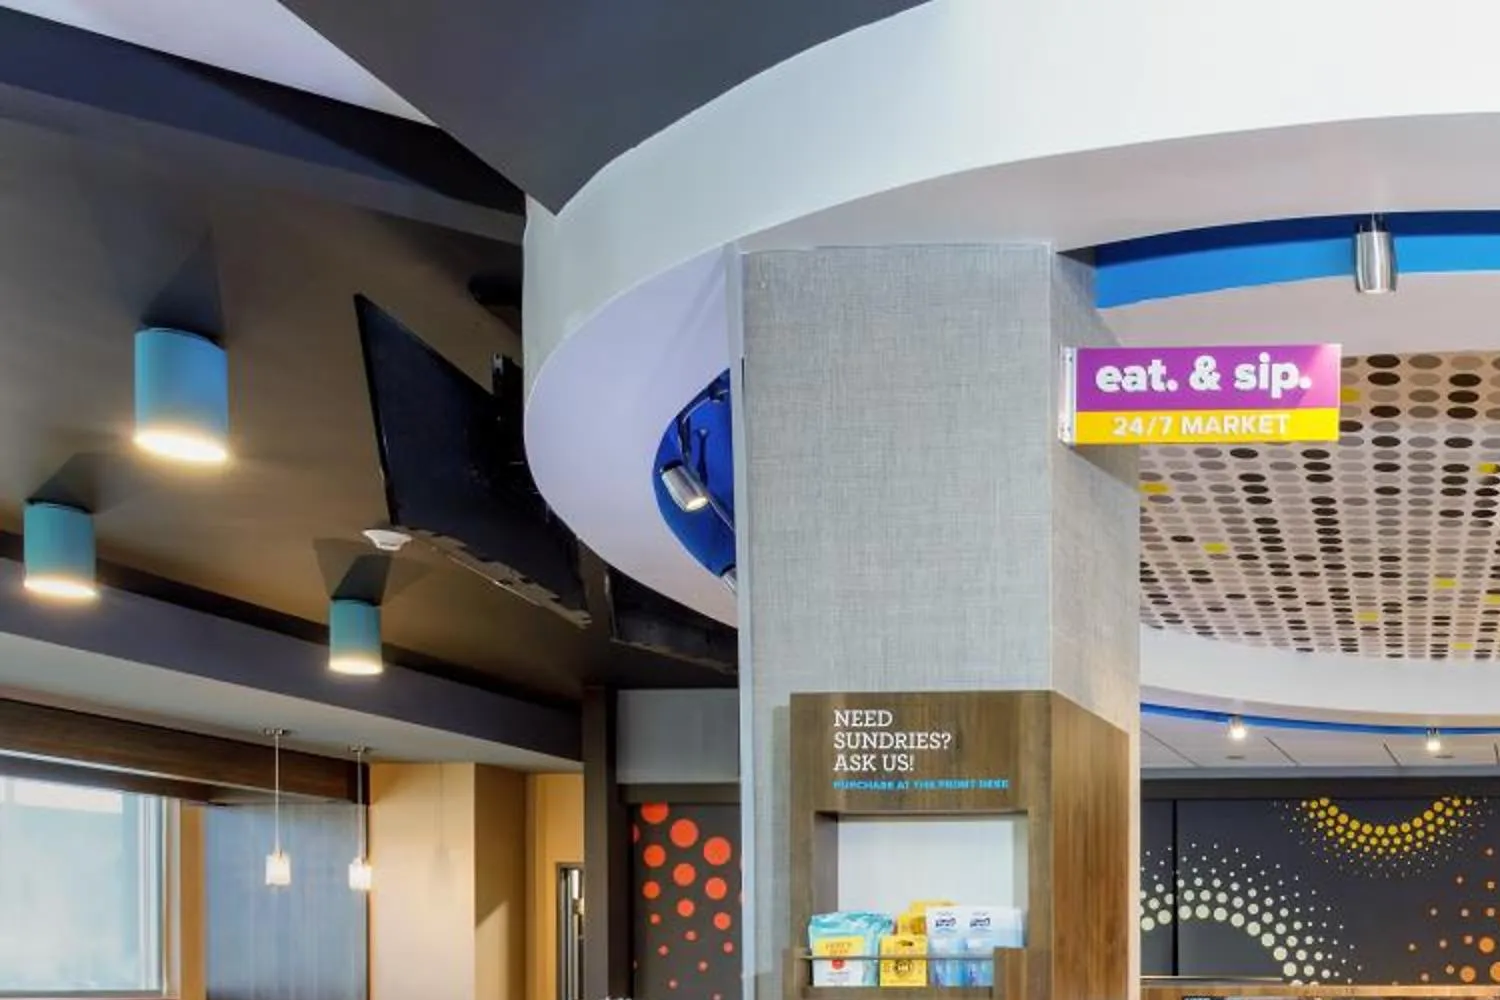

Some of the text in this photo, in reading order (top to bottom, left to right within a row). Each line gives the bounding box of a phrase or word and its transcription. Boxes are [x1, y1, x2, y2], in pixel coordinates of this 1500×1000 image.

[1095, 351, 1313, 400] eat. & sip.
[1111, 413, 1291, 437] 24/7 MARKET
[832, 709, 894, 728] NEED
[832, 731, 952, 751] SUNDRIES?
[832, 753, 915, 772] ASK US!
